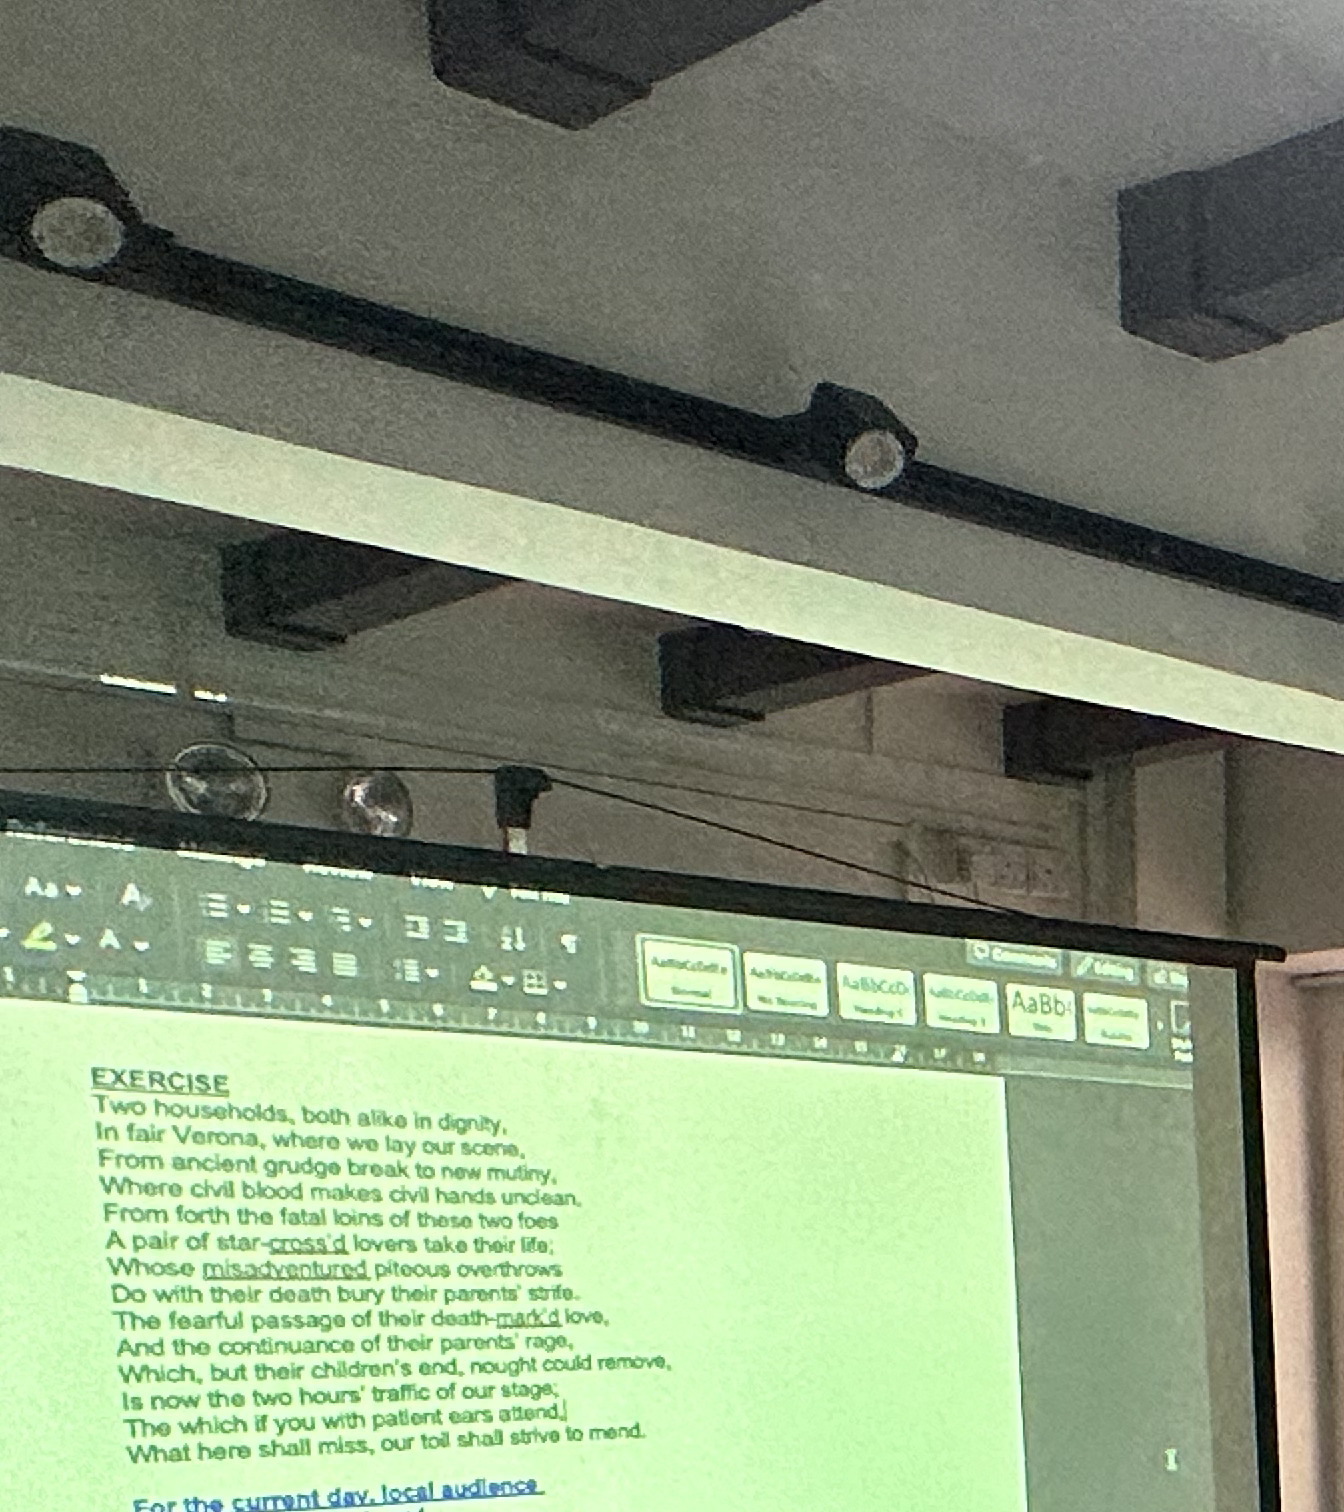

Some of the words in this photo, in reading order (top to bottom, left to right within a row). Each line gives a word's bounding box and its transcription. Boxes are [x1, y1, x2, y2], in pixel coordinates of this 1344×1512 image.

[90, 1067, 229, 1097] EXERCISE
[94, 1094, 147, 1115] Two
[300, 1106, 351, 1125] both
[357, 1109, 408, 1129] alike
[414, 1112, 432, 1129] in
[95, 1121, 120, 1141] In
[126, 1123, 166, 1143] fair
[271, 1130, 340, 1150] where
[346, 1137, 380, 1151] we
[384, 1135, 417, 1158] lay
[421, 1140, 456, 1155] our
[98, 1148, 165, 1169] From
[171, 1153, 258, 1173] ancient
[262, 1157, 342, 1179] grudge
[346, 1157, 410, 1178] break
[414, 1162, 436, 1179] to
[440, 1166, 482, 1180] new
[98, 1175, 184, 1197] Where
[189, 1179, 236, 1198] civil
[241, 1181, 304, 1200] blood
[310, 1184, 384, 1202] makes
[388, 1185, 430, 1204] civil
[434, 1187, 497, 1205] hands
[102, 1203, 170, 1223] From
[174, 1205, 230, 1225] forth
[236, 1207, 274, 1225] the
[279, 1207, 327, 1226] fatal
[332, 1208, 384, 1227] loins
[388, 1209, 411, 1227] of
[416, 1212, 473, 1229] these
[477, 1213, 514, 1229] two
[516, 1211, 560, 1229] foes
[104, 1229, 126, 1249] A
[131, 1231, 180, 1253] pair
[184, 1231, 209, 1251] of
[352, 1234, 418, 1253] lovers
[422, 1236, 468, 1253] take
[472, 1237, 516, 1253] their
[106, 1257, 196, 1277] Whose
[202, 1259, 370, 1281] misadventured
[374, 1259, 452, 1281] piteous
[456, 1261, 564, 1278] overthrows
[110, 1283, 148, 1303] Do
[152, 1285, 204, 1303] with
[208, 1286, 262, 1303] their
[268, 1287, 332, 1303] death
[336, 1285, 386, 1305] bury
[390, 1285, 438, 1302] their
[443, 1284, 521, 1305] parents'
[112, 1311, 162, 1331] The
[168, 1310, 244, 1329] fearful
[250, 1315, 346, 1333] passage
[350, 1309, 372, 1327] of
[377, 1309, 426, 1327] their
[116, 1337, 166, 1357] And
[170, 1338, 212, 1356] the
[217, 1337, 356, 1356] continuance
[360, 1334, 381, 1353] of
[386, 1334, 434, 1351] their
[440, 1331, 519, 1355] parents'
[209, 1363, 247, 1381] but
[253, 1363, 305, 1381] their
[310, 1359, 413, 1379] children's
[469, 1357, 538, 1377] nought
[541, 1354, 592, 1372] could
[122, 1392, 144, 1411] Is
[150, 1395, 202, 1410] now
[206, 1389, 246, 1408] the
[251, 1389, 293, 1407] two
[298, 1385, 366, 1405] hours'
[370, 1383, 431, 1403] traffic
[435, 1382, 456, 1400] of
[460, 1385, 497, 1399] our
[122, 1419, 172, 1438] The
[177, 1415, 249, 1435] which
[254, 1414, 268, 1432] if
[272, 1416, 316, 1436] you
[320, 1411, 366, 1429] with
[371, 1409, 443, 1431] patient
[448, 1409, 494, 1424] ears
[126, 1443, 191, 1464] What
[196, 1442, 252, 1461] here
[258, 1435, 312, 1457] shall
[380, 1437, 415, 1451] our
[420, 1431, 450, 1449] toil
[456, 1429, 504, 1447] shall
[509, 1427, 561, 1445] strive
[564, 1426, 584, 1441] to
[380, 1481, 434, 1506] local
[441, 1478, 544, 1501] audience
